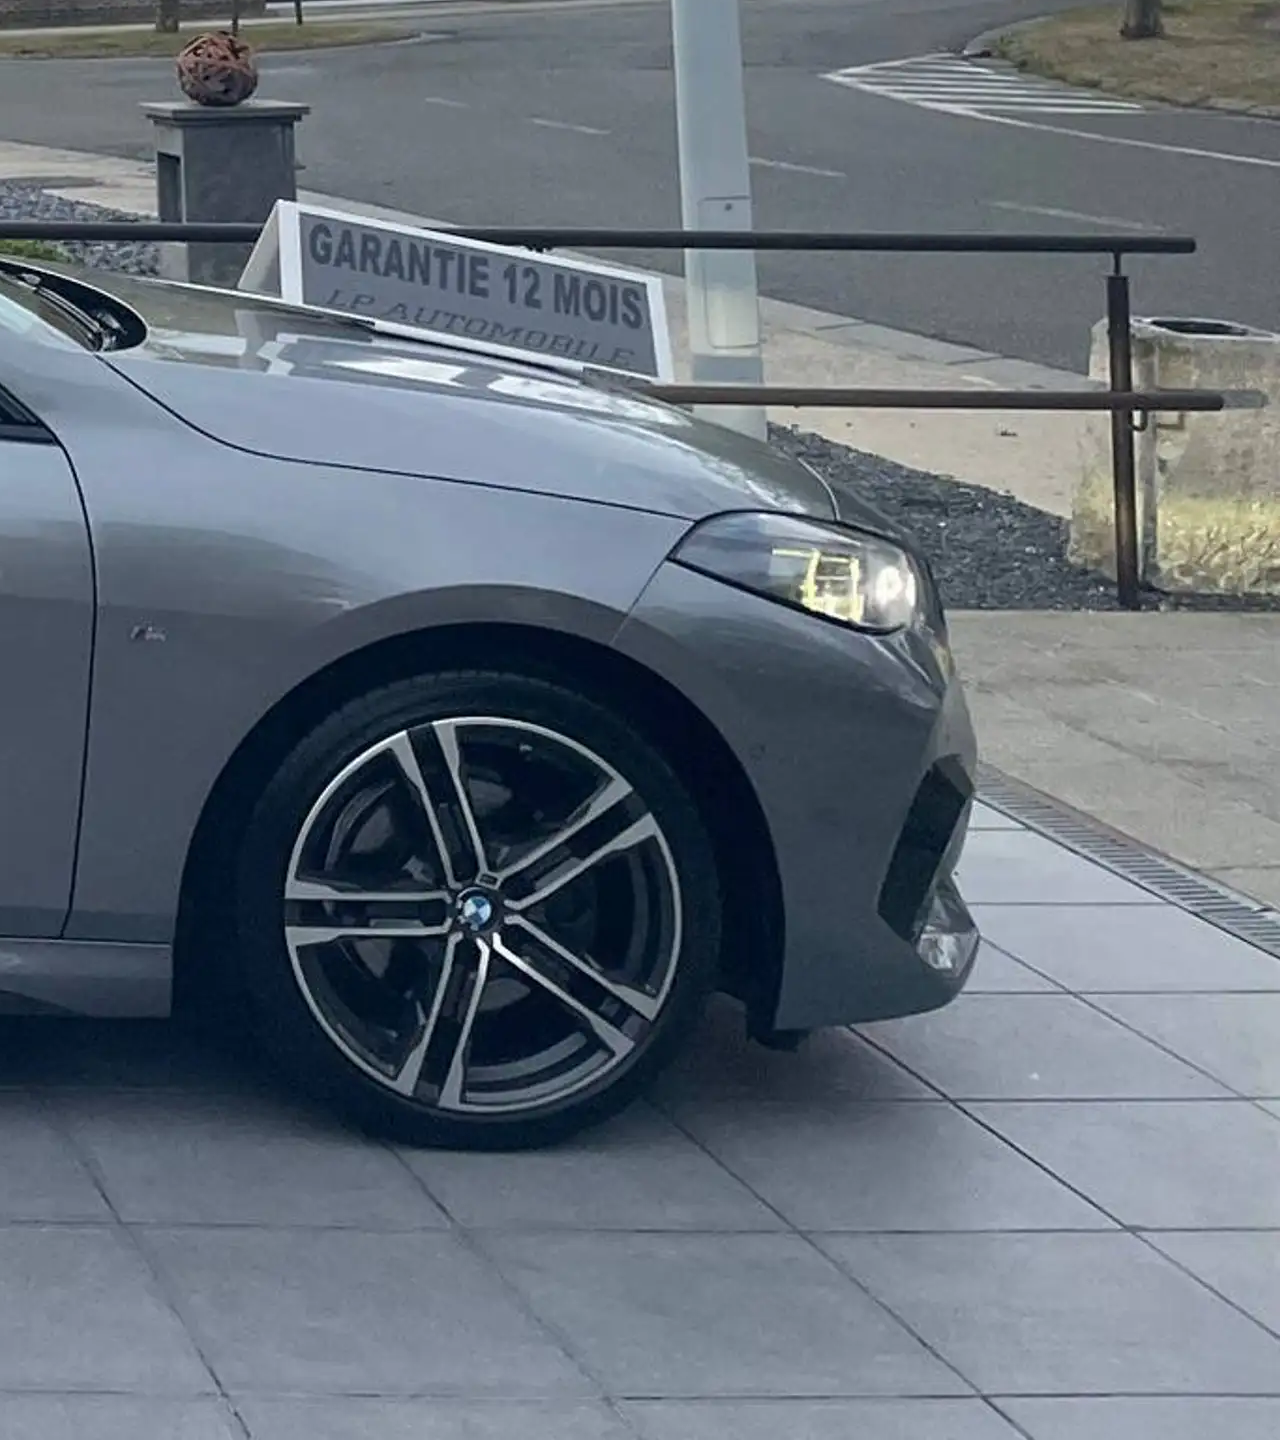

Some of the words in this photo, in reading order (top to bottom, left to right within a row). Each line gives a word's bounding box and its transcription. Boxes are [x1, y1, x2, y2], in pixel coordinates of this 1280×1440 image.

[309, 223, 490, 299] GARANTIE
[503, 262, 542, 310] 12
[553, 272, 644, 330] MOIS
[382, 302, 637, 366] AUTOMOBILE
